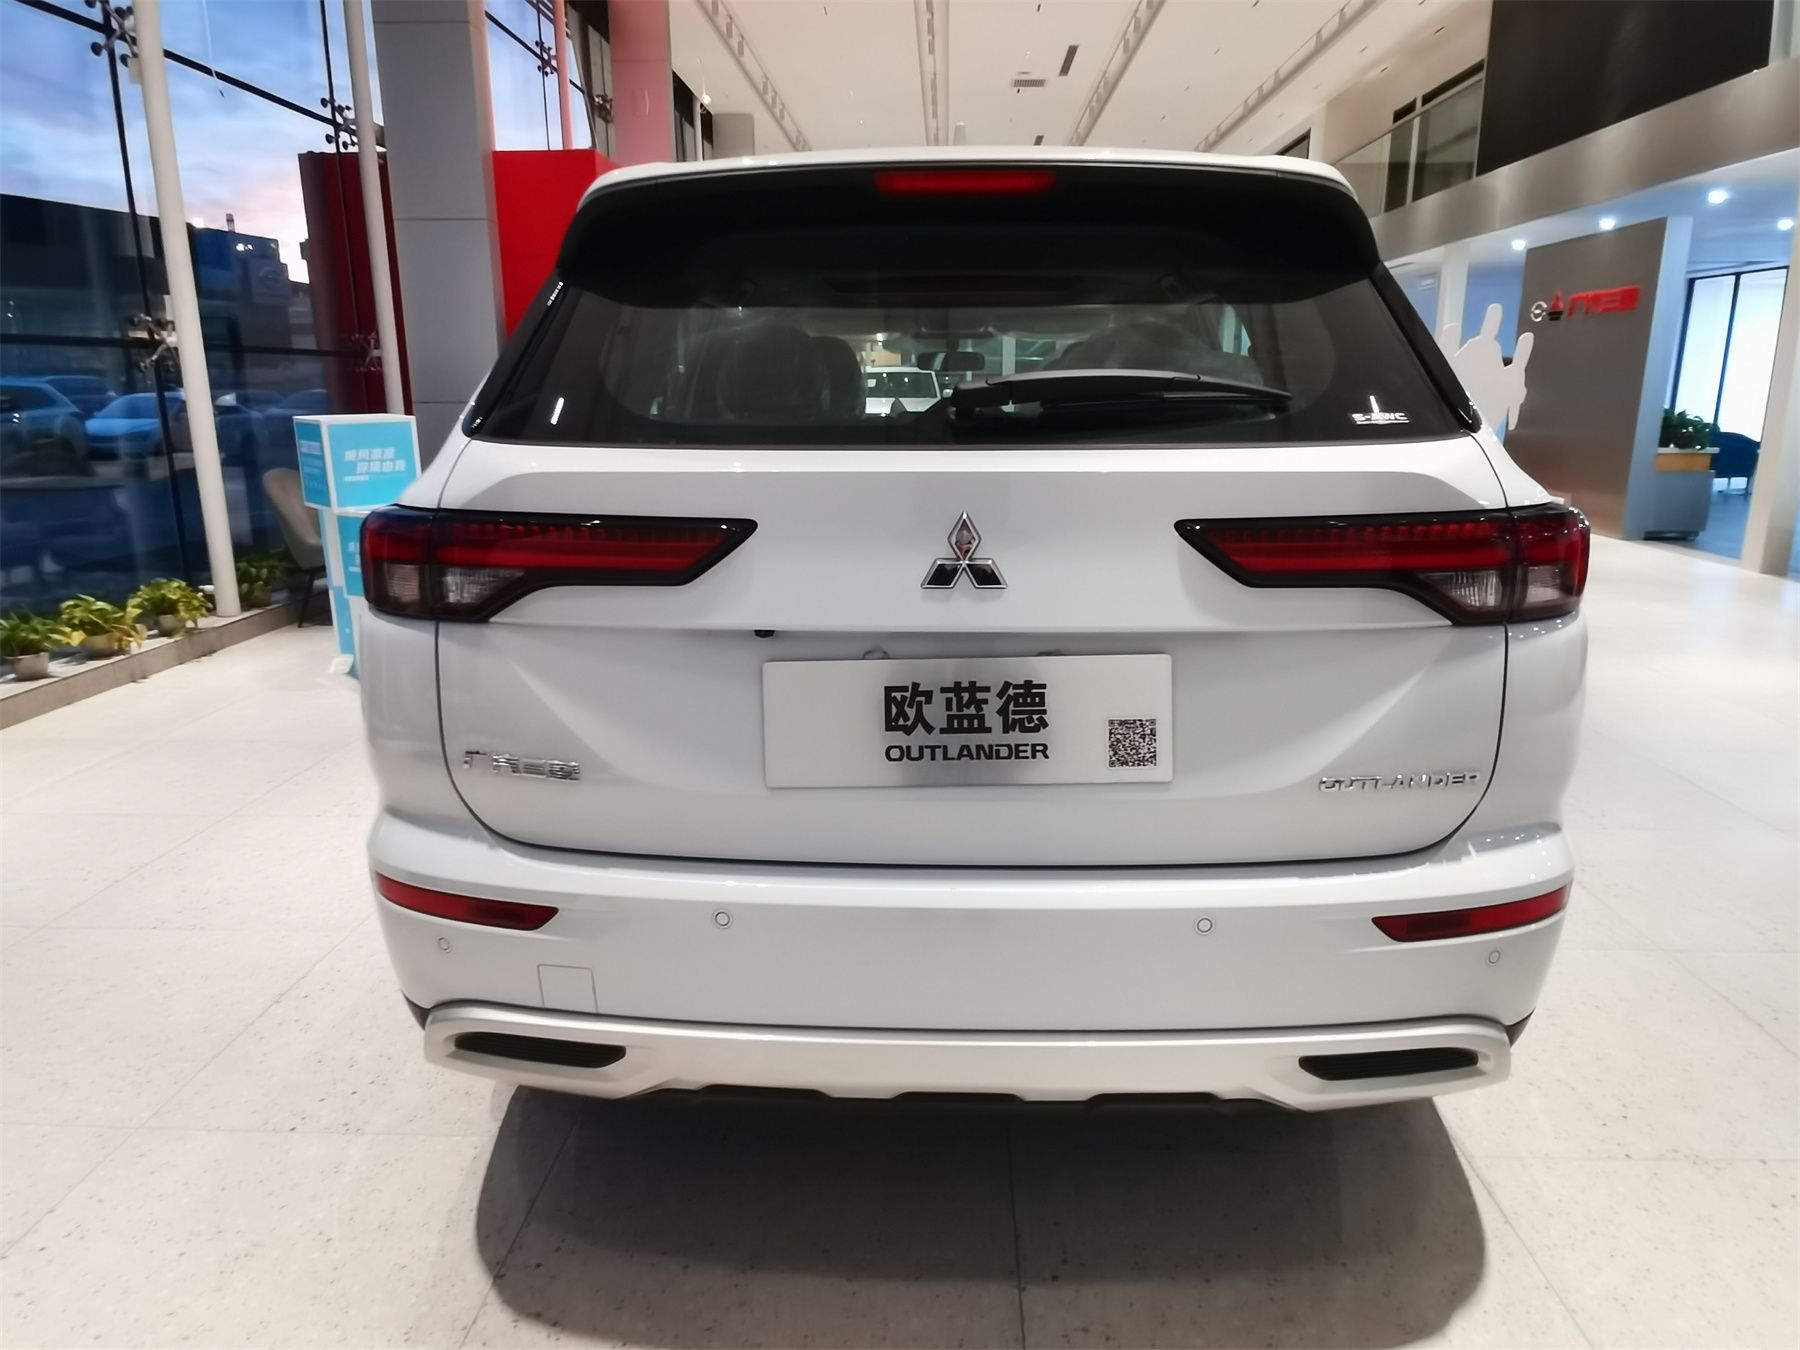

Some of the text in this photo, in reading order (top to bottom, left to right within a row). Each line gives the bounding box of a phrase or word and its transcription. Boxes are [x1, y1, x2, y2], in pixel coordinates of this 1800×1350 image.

[884, 680, 1049, 736] 欧蓝德
[885, 743, 1049, 762] OUTLANDER
